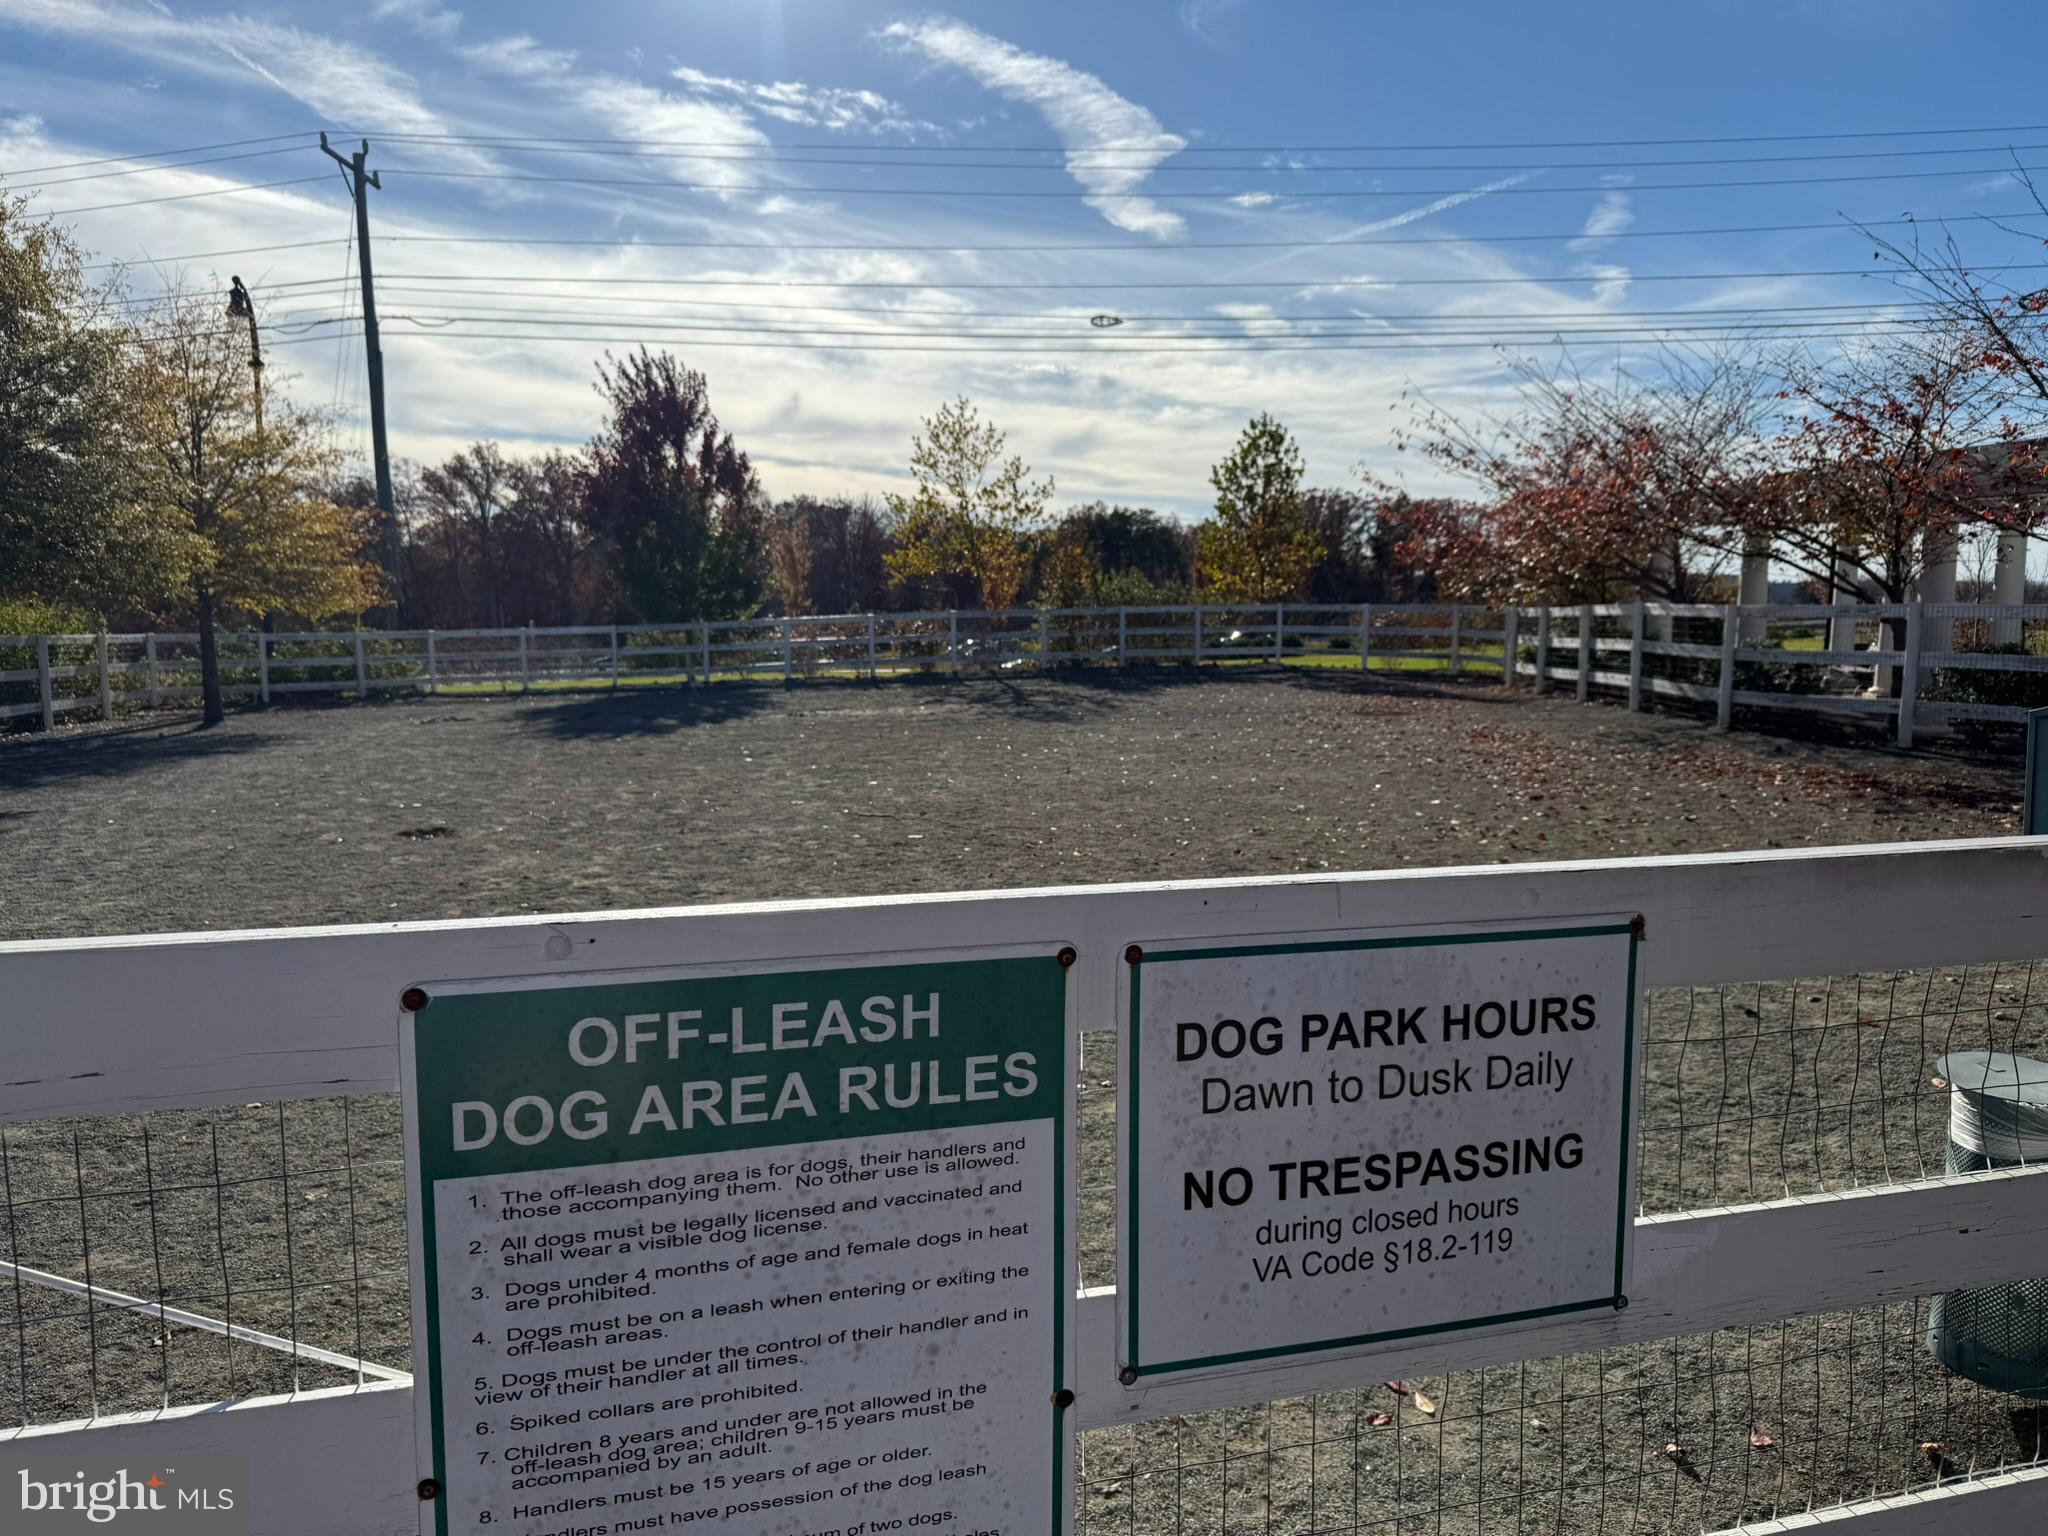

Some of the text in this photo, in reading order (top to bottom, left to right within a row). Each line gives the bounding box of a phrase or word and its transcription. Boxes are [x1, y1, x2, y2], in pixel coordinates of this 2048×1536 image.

[567, 992, 940, 1070] OFF-LEASH
[1175, 993, 1596, 1063] DOG PARK HOURS
[451, 1051, 1038, 1152] DOG AREA RULES
[1202, 1050, 1574, 1115] Dawn to Dusk Daily
[468, 1136, 1026, 1209] 1. The off-leash dog area is for dogs, their handlers and
[501, 1151, 1020, 1221] those accompanying them. No other use is allowed.
[1183, 1132, 1584, 1211] NO TRESPASSING
[468, 1179, 1022, 1256] 2. All dogs must be legally licensed and vaccinated and
[503, 1220, 829, 1267] shall wear a visible dog license.
[1255, 1197, 1519, 1246] during closed hours
[471, 1221, 1029, 1301] 3. Dogs under 4 months of age and female dogs in heat
[1251, 1226, 1514, 1283] VA Code §18.2-119
[471, 1265, 1030, 1346] 4. Dogs must be on a leash when entering or exiting the
[505, 1282, 657, 1312] are prohibited.
[474, 1308, 1029, 1391] 5. Dogs must be under the control of their handler and in
[506, 1328, 669, 1357] off-leash areas.
[474, 1354, 804, 1406] view of their handler at all times.
[475, 1379, 804, 1436] 6. Spiked collars are prohibited.
[476, 1383, 988, 1466] 7. Children 8 years and under are not allowed in the
[510, 1398, 975, 1476] off-leash dog area; children 9-15 years must be
[479, 1446, 933, 1525] 8. Handlers must be 15 years of age or older.
[511, 1441, 772, 1490] accompanied by an adult.
[614, 1513, 665, 1534] must
[670, 1507, 719, 1525] have
[725, 1489, 834, 1519] possession
[839, 1481, 859, 1497] of
[863, 1480, 893, 1494] the
[898, 1473, 933, 1488] dog
[938, 1463, 987, 1482] leash
[846, 1521, 866, 1536] of
[870, 1512, 904, 1533] two
[908, 1508, 958, 1527] dogs.
